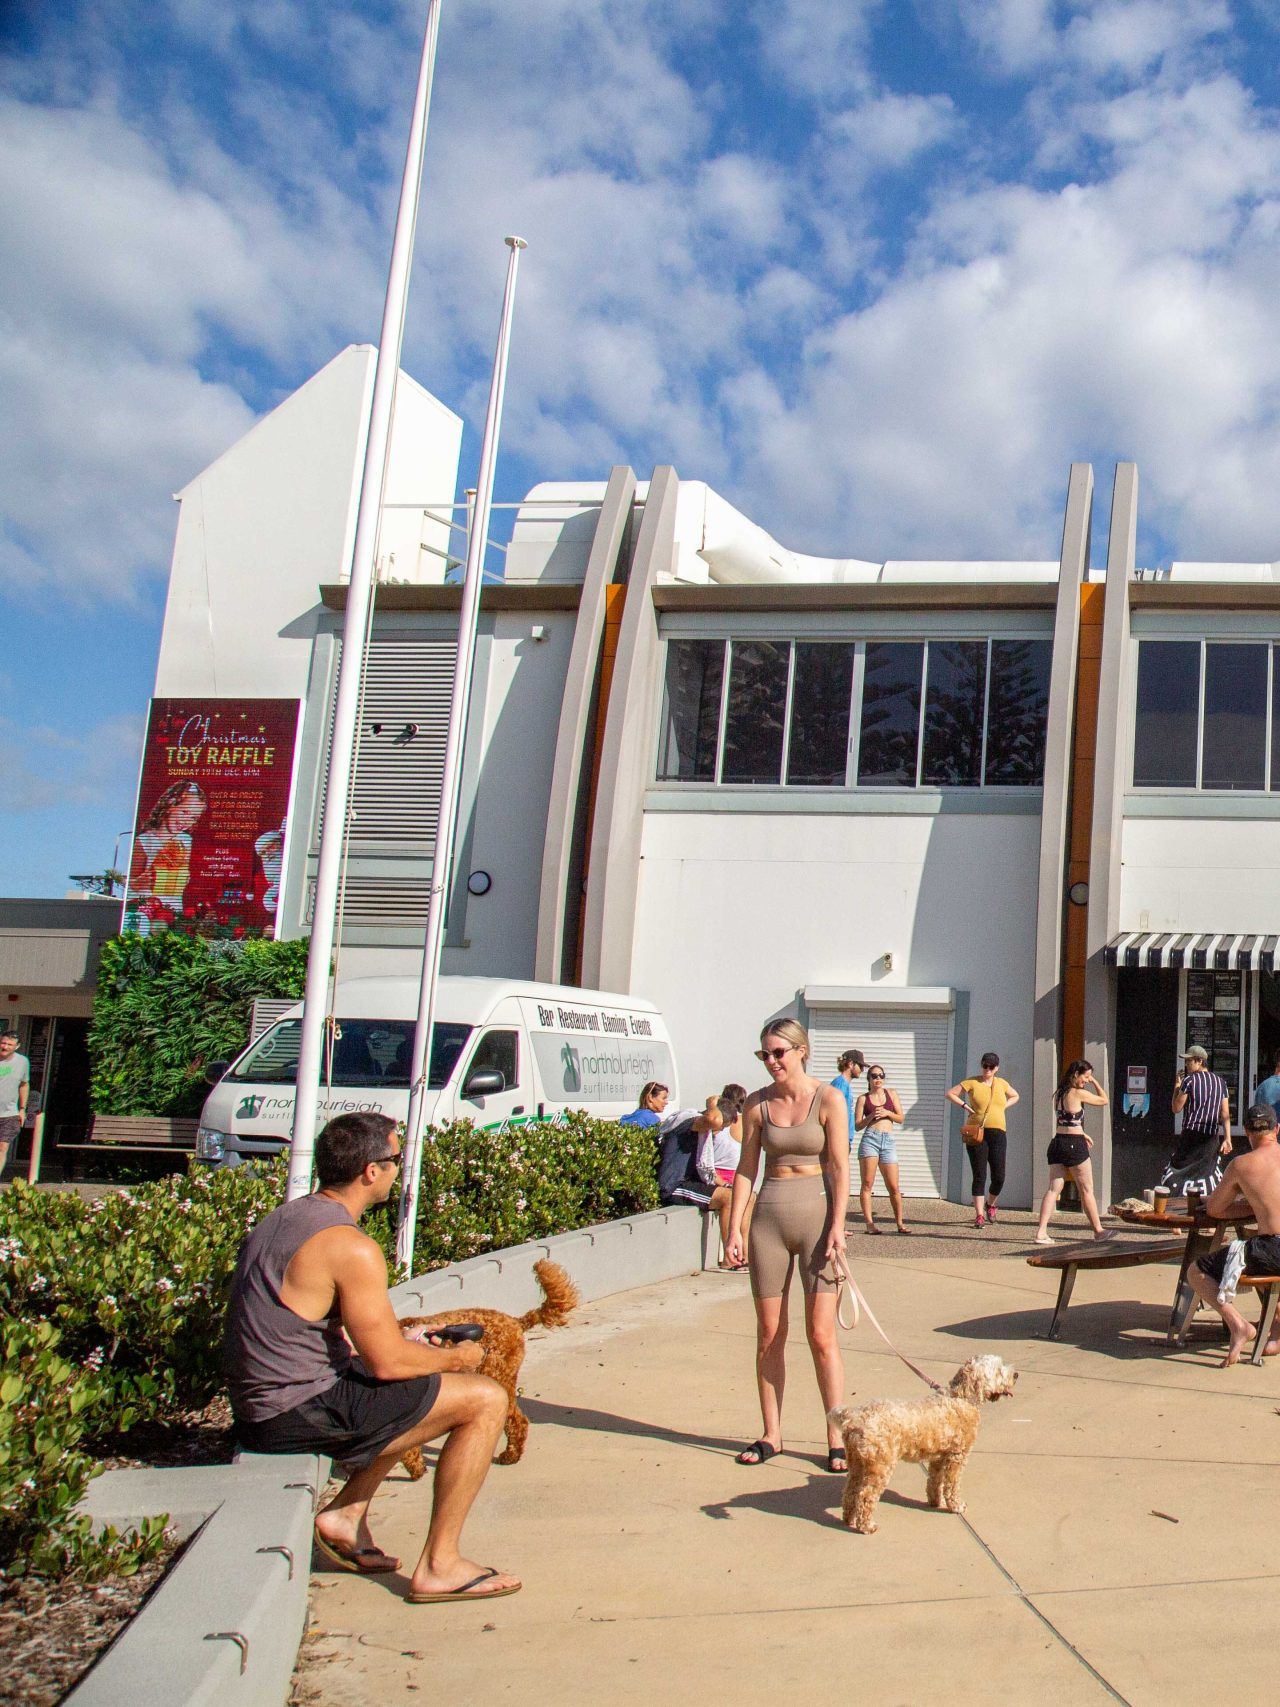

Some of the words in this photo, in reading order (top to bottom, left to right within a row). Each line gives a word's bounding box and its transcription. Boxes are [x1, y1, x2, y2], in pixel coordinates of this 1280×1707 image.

[178, 714, 267, 752] Christmas
[165, 746, 202, 765] TOY
[207, 747, 275, 765] RAFFLE
[168, 768, 199, 776] SUNDAY
[538, 1005, 554, 1027] Bar
[557, 1007, 600, 1032] Restaurant
[601, 1012, 629, 1037] Gaming
[629, 1015, 653, 1036] Events
[582, 1051, 655, 1081] northburleigh
